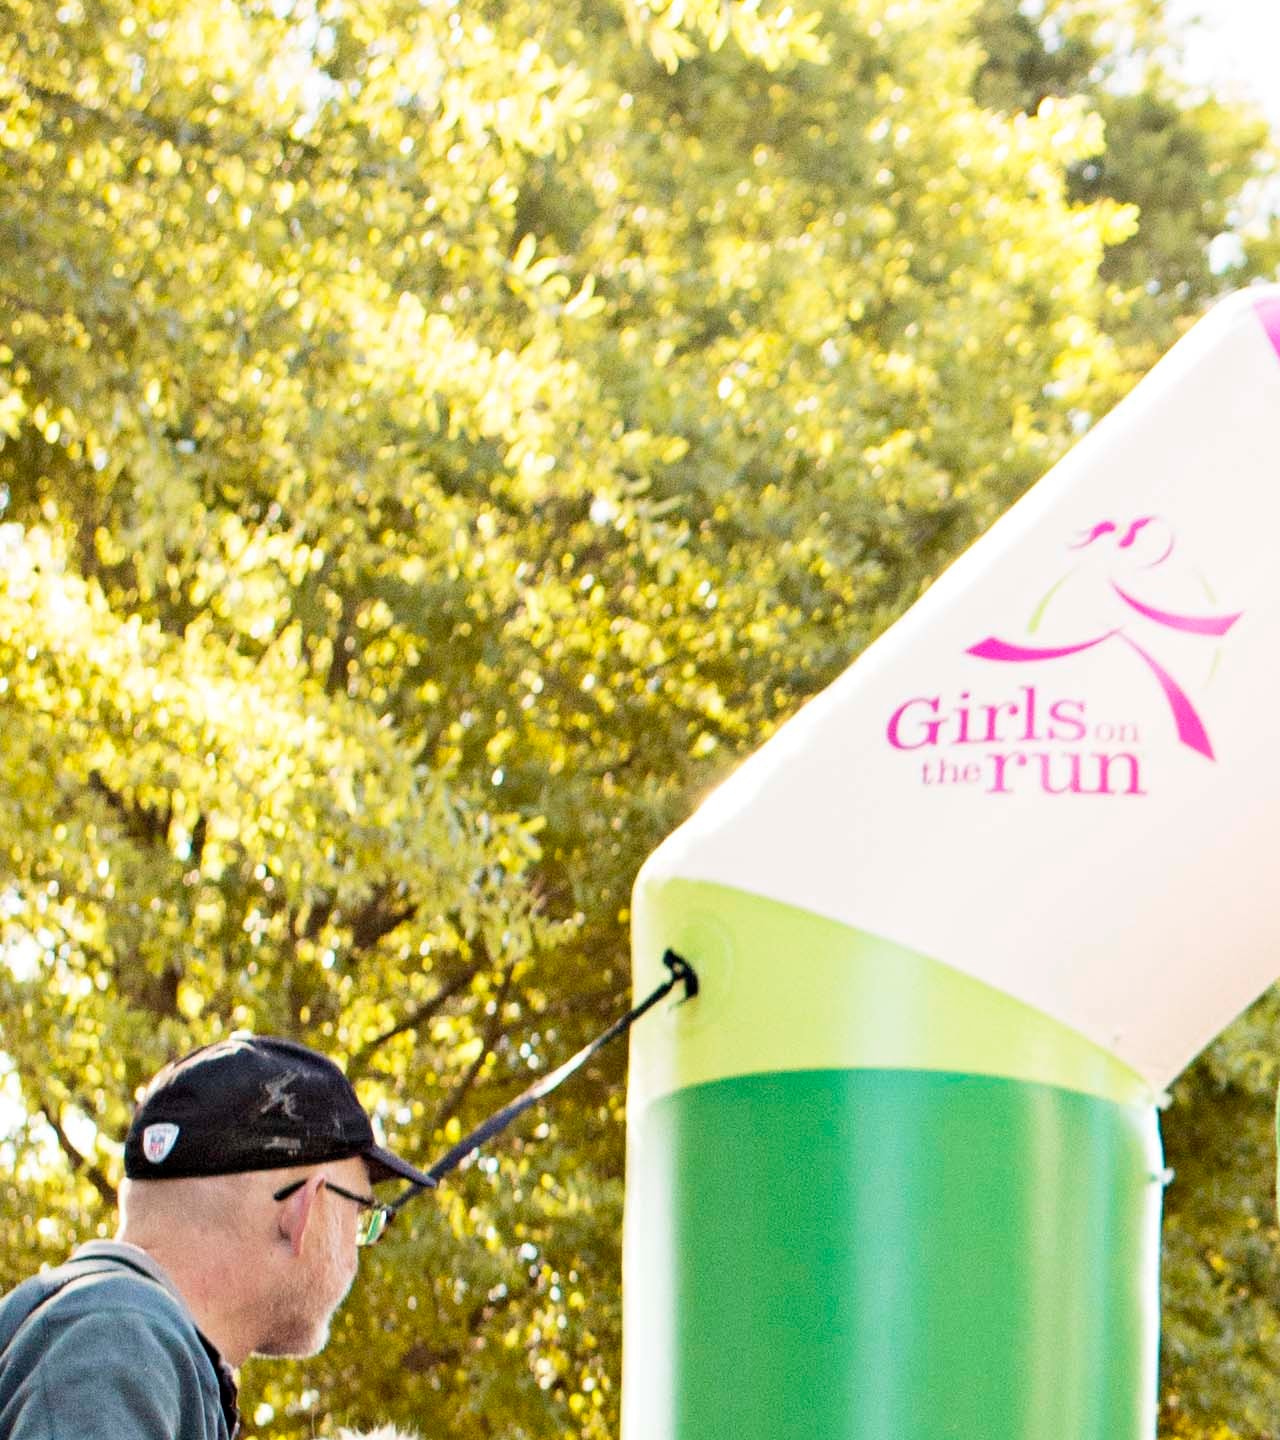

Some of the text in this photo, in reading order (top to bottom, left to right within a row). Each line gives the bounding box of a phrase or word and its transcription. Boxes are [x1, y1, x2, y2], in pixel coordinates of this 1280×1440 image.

[886, 685, 1140, 751] Girls on
[921, 750, 1149, 796] the run
